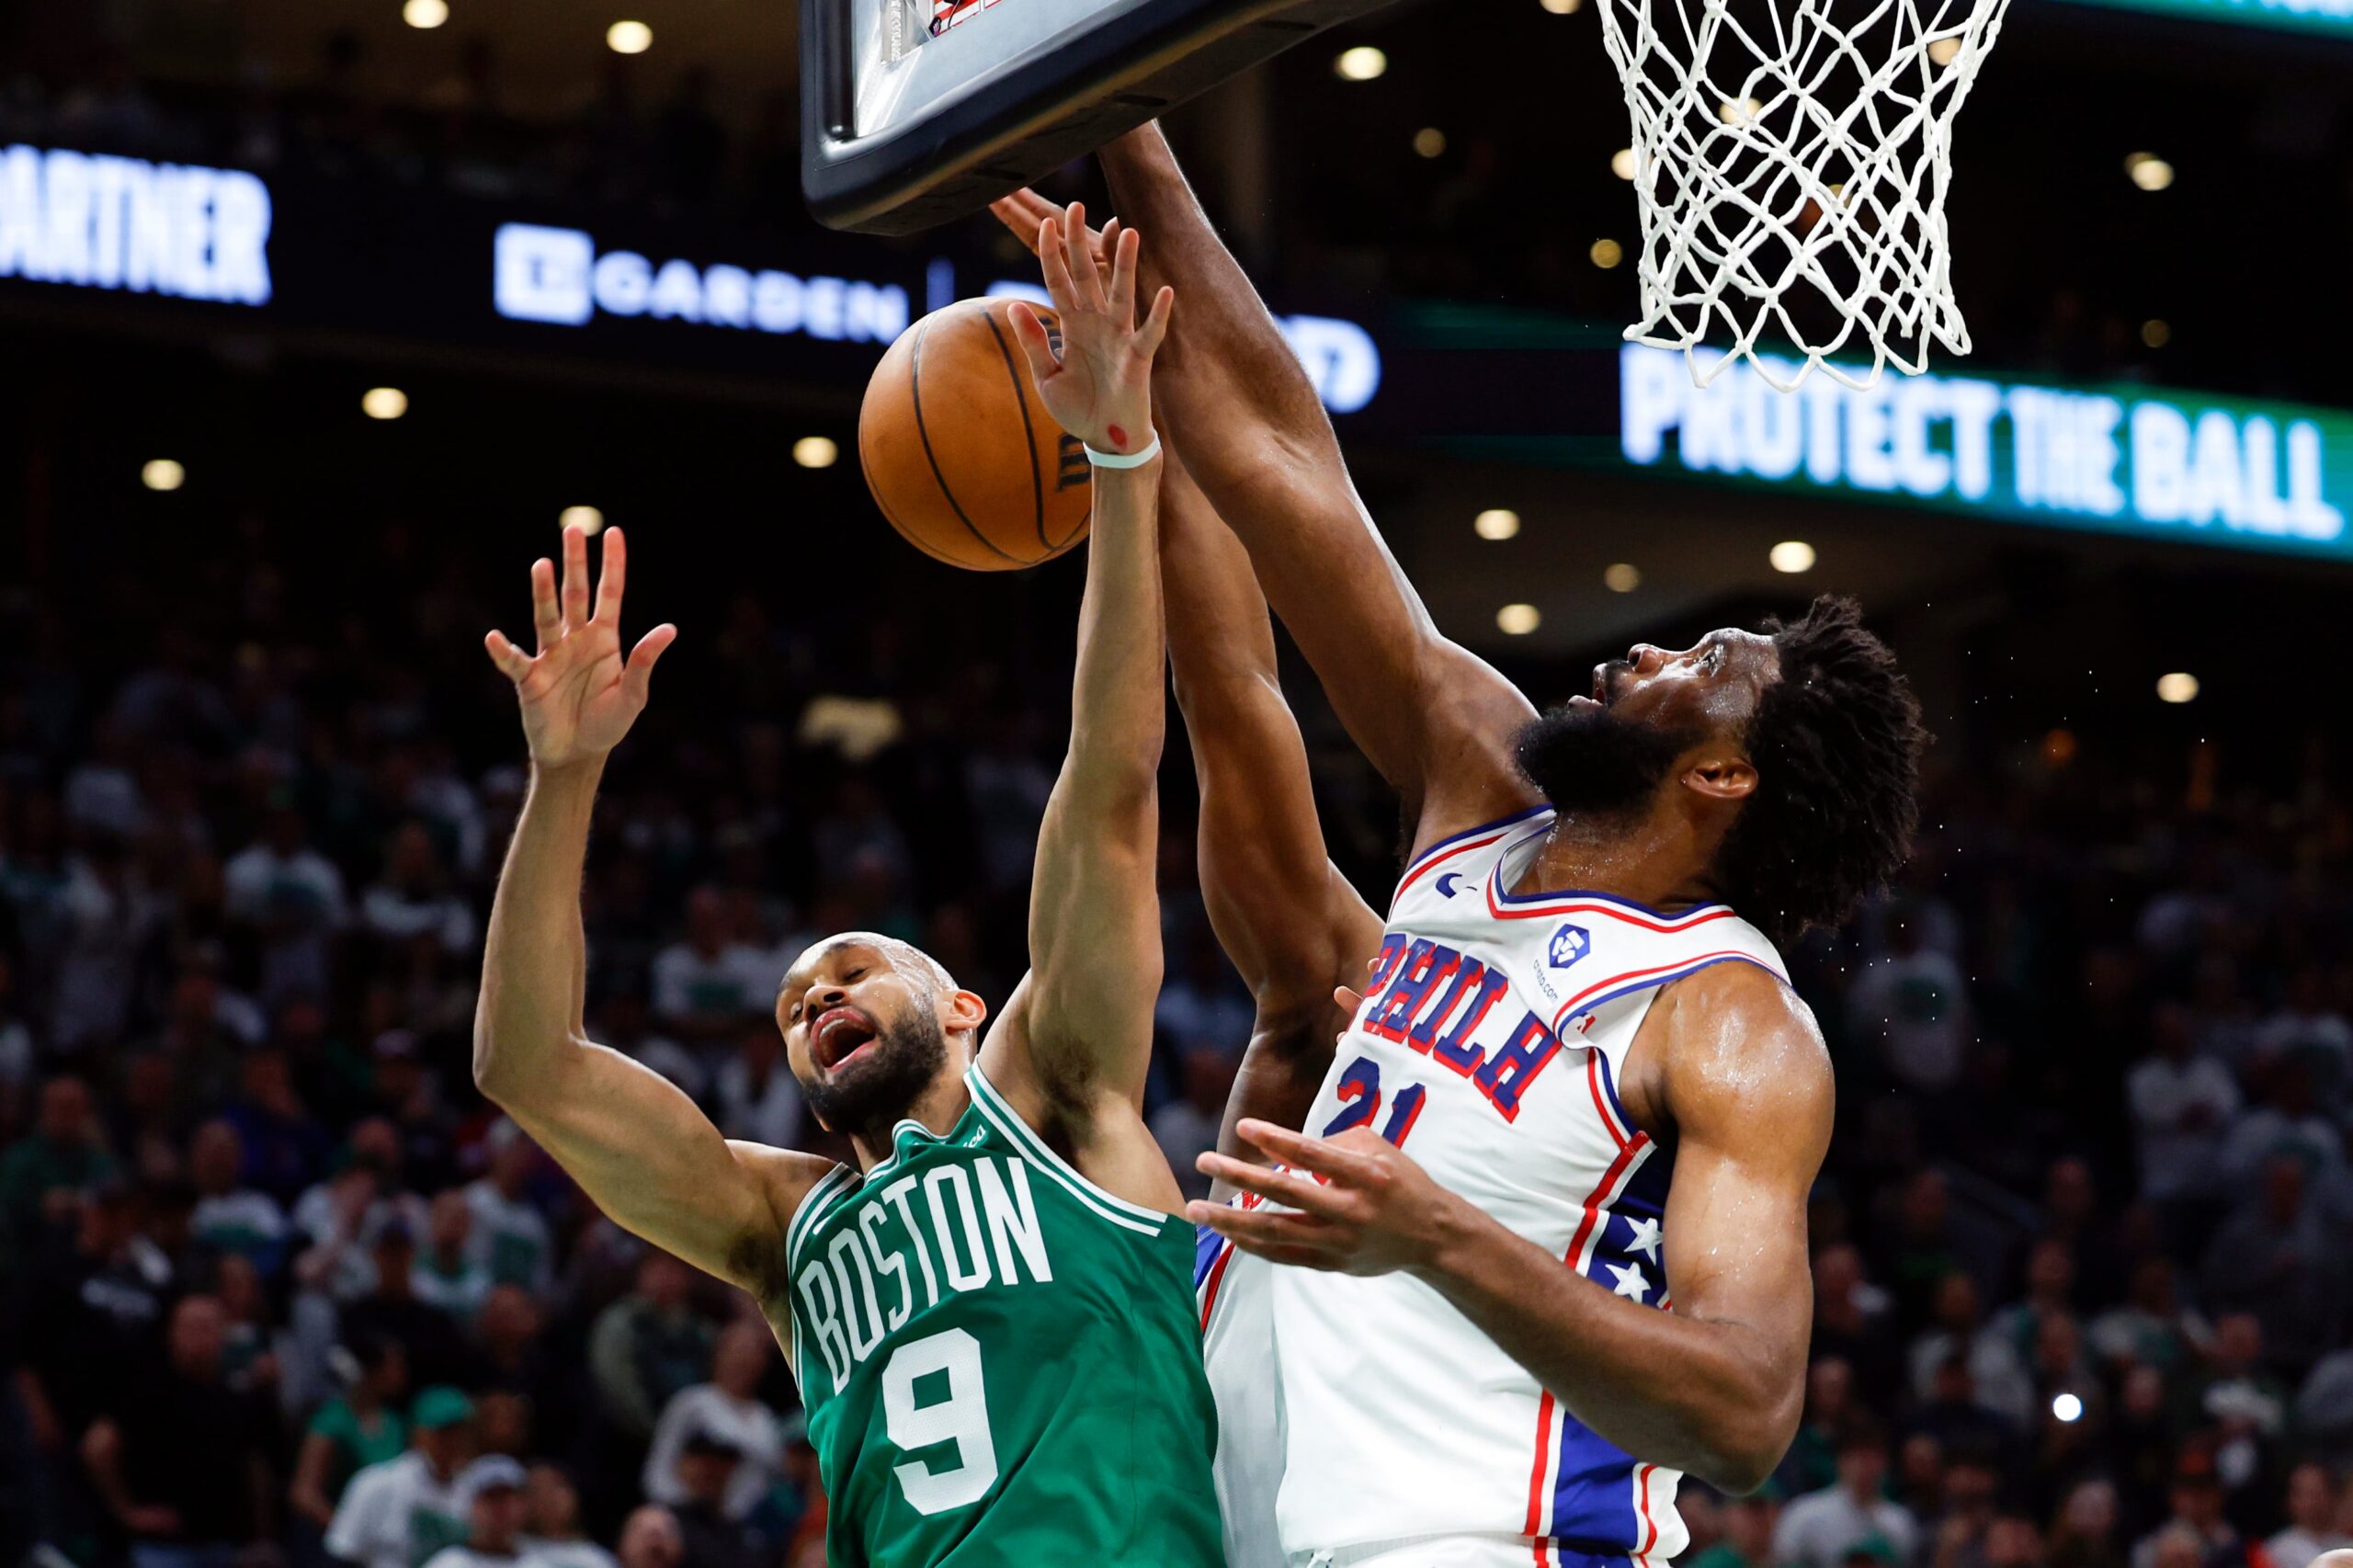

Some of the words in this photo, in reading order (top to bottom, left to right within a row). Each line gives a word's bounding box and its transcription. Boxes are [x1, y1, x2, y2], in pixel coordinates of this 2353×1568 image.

[0, 144, 271, 305] ARTNER
[593, 250, 910, 346] GARDEN
[1620, 340, 2001, 502] PROTECT
[2007, 386, 2126, 517] THE
[2130, 400, 2344, 540] BALL
[1322, 1056, 1427, 1149] 21
[1363, 933, 1563, 1125] PHILA
[797, 1155, 1053, 1397] BOSTON
[881, 1327, 999, 1517] 9
